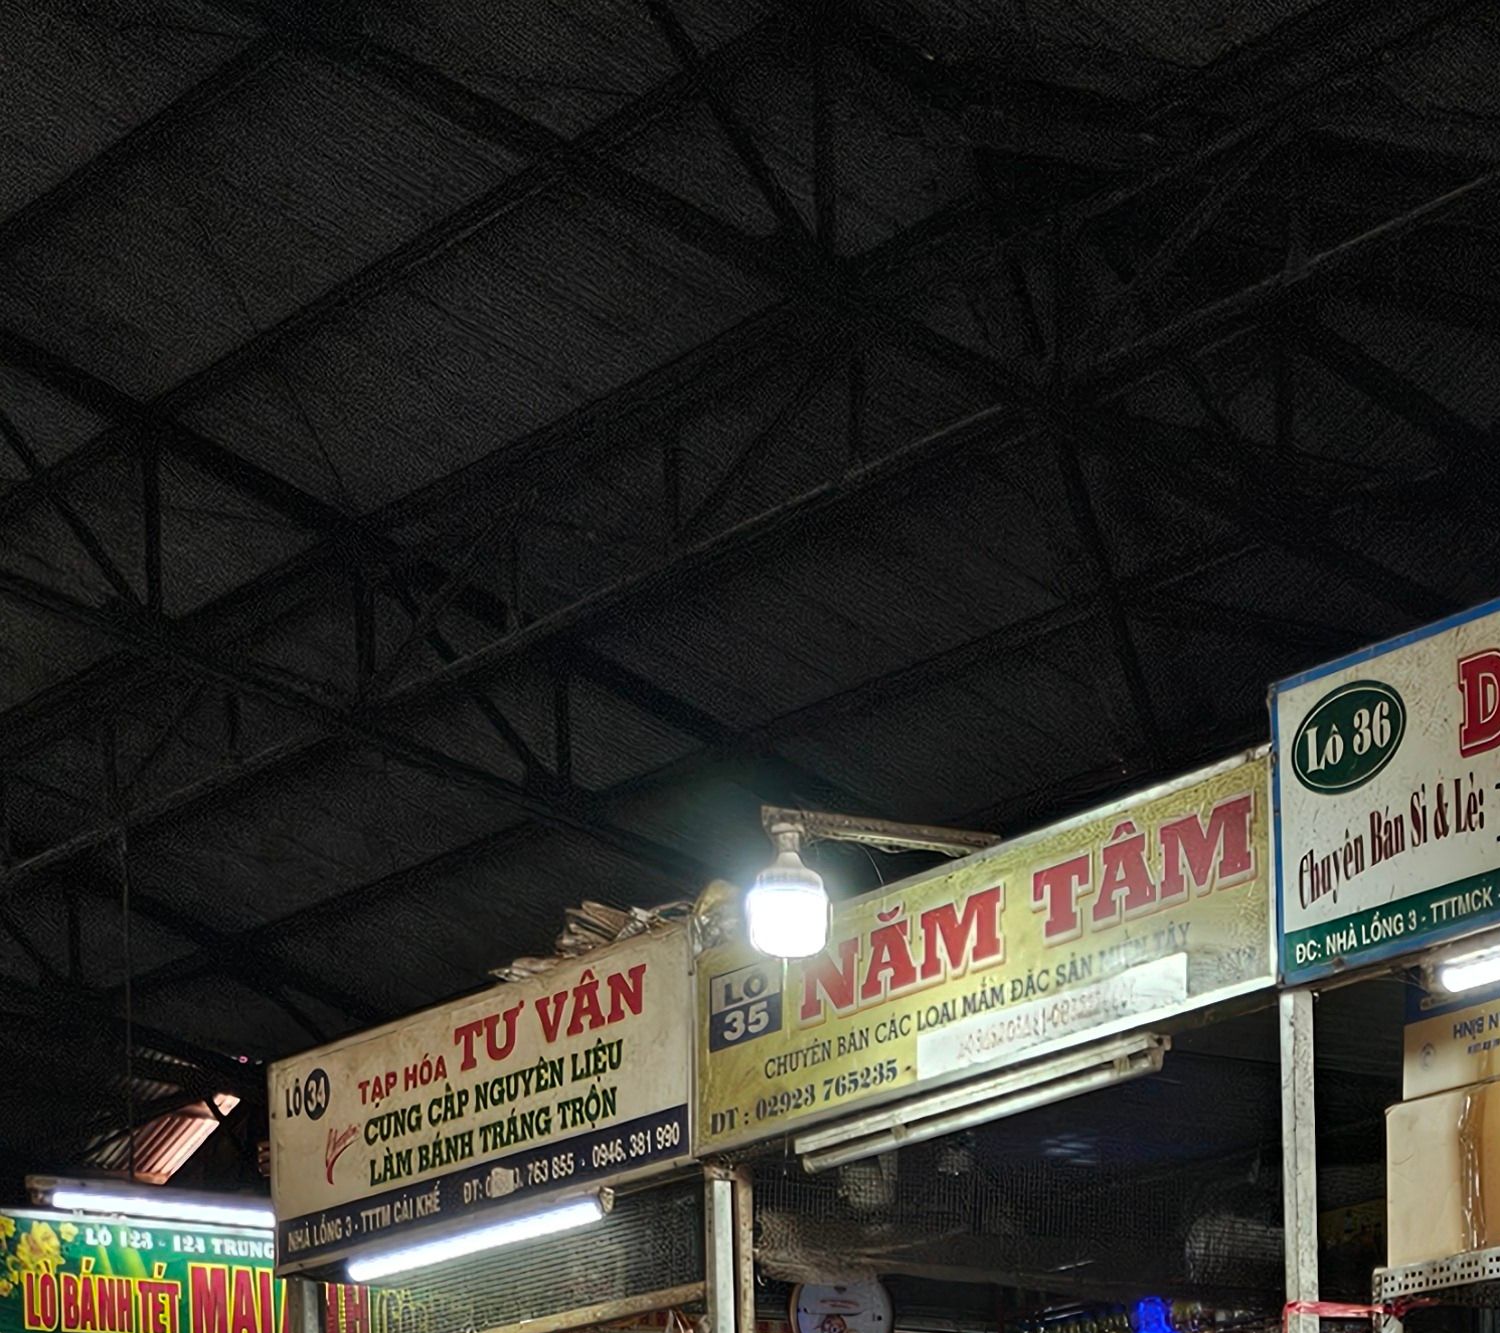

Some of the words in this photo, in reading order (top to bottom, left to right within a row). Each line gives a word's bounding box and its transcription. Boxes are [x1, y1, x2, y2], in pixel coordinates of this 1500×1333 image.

[1305, 723, 1343, 774] Lô
[1353, 701, 1391, 755] 36
[1299, 828, 1364, 910] Chuyên
[1369, 806, 1405, 868] Bán
[1433, 783, 1449, 840] &
[800, 886, 1002, 1024] NĂM
[1032, 793, 1254, 940] TÂM
[1326, 924, 1357, 954] NHÀ
[1408, 910, 1417, 931] 3
[1430, 886, 1493, 924] TTTMCK
[358, 1072, 398, 1108] TẠP
[404, 1053, 447, 1091] HÓA
[455, 1001, 524, 1073] TƯ
[535, 963, 647, 1043] VÂN
[724, 1001, 769, 1041] 35
[765, 1038, 832, 1079] CHUYÊN
[837, 1025, 870, 1057] BÁN
[875, 1014, 911, 1044] CÁC
[308, 1076, 326, 1113] 34
[364, 1104, 422, 1146] CUNG
[474, 1056, 564, 1113] NGUYÊN
[571, 1038, 623, 1082] LIỆU
[823, 1059, 898, 1101] 765235
[370, 1147, 413, 1186] LÀM
[418, 1131, 474, 1173] BÁNH
[479, 1108, 552, 1153] TRÁNG
[557, 1084, 617, 1129] TRỘN
[345, 1216, 352, 1238] 3
[360, 1203, 391, 1233] TTTM
[528, 1159, 549, 1186] 763
[551, 1153, 575, 1179] 855
[629, 1129, 652, 1156] 381
[210, 1237, 275, 1260] TRUNG
